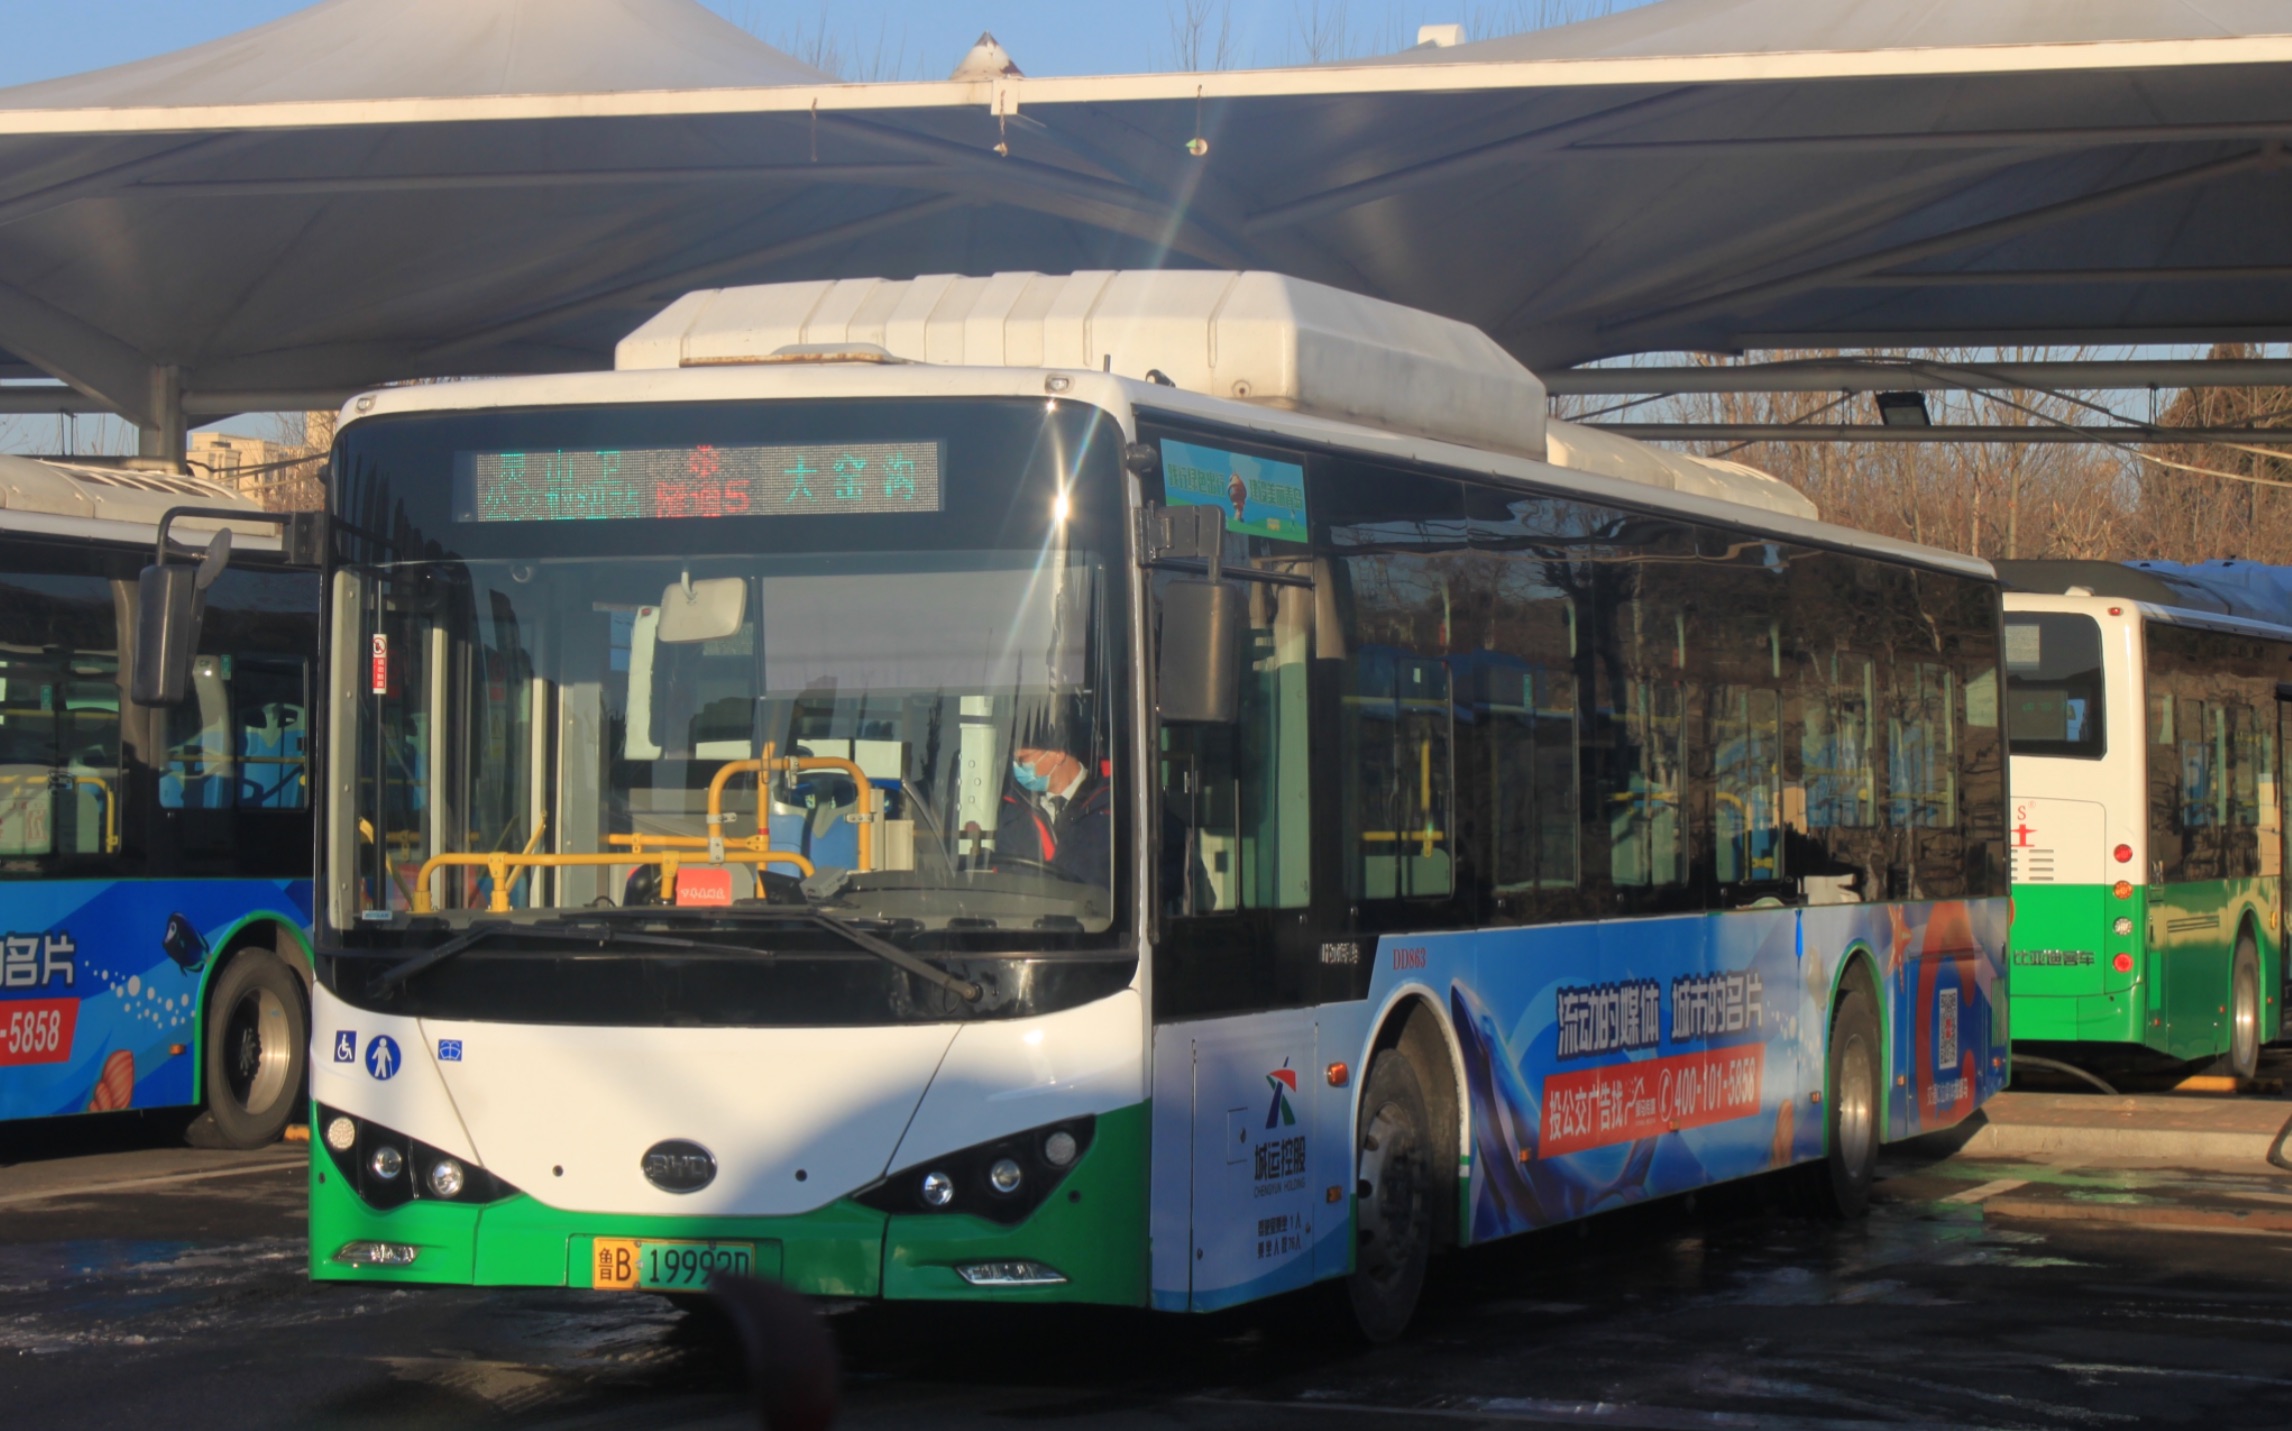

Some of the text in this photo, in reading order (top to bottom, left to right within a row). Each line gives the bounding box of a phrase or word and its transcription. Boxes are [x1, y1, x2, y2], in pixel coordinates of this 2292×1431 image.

[0, 934, 75, 987] 名片
[2013, 949, 2096, 967] 比亚迪客车
[1557, 972, 1763, 1057] 流动的媒体 城市的名片
[1549, 1056, 1757, 1141] 投公交广告找 400-101-5858
[1254, 1136, 1306, 1181] 城运控股
[1283, 1176, 1306, 1192] HOLDING
[598, 1247, 632, 1282] 鲁B
